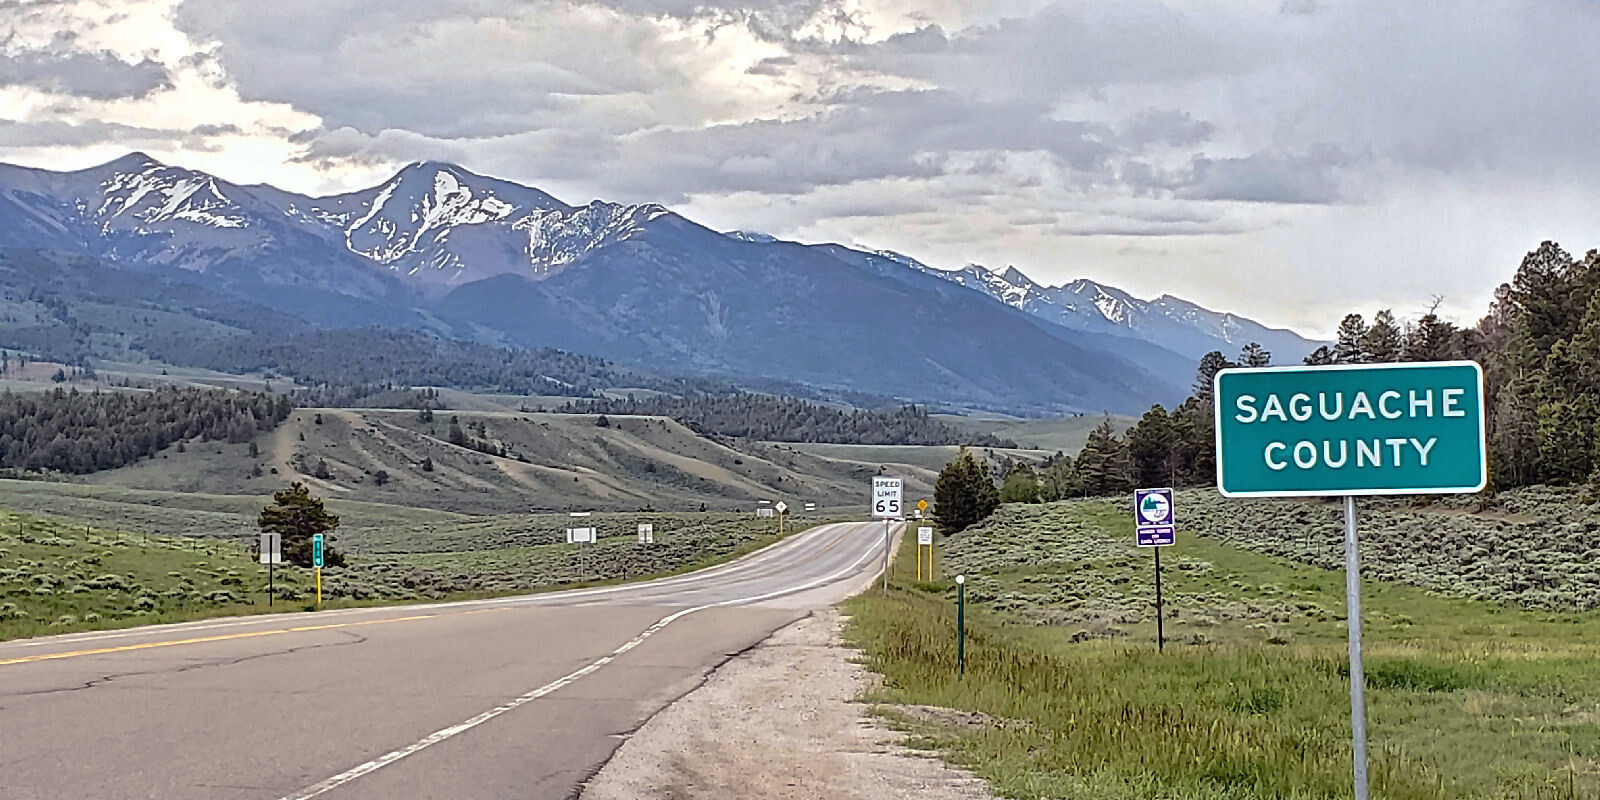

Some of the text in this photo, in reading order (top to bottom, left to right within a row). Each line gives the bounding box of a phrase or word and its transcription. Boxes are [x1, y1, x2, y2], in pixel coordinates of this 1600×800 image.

[1235, 388, 1465, 423] SAGUACHE
[1264, 438, 1437, 470] COUNTY
[876, 500, 899, 512] 65
